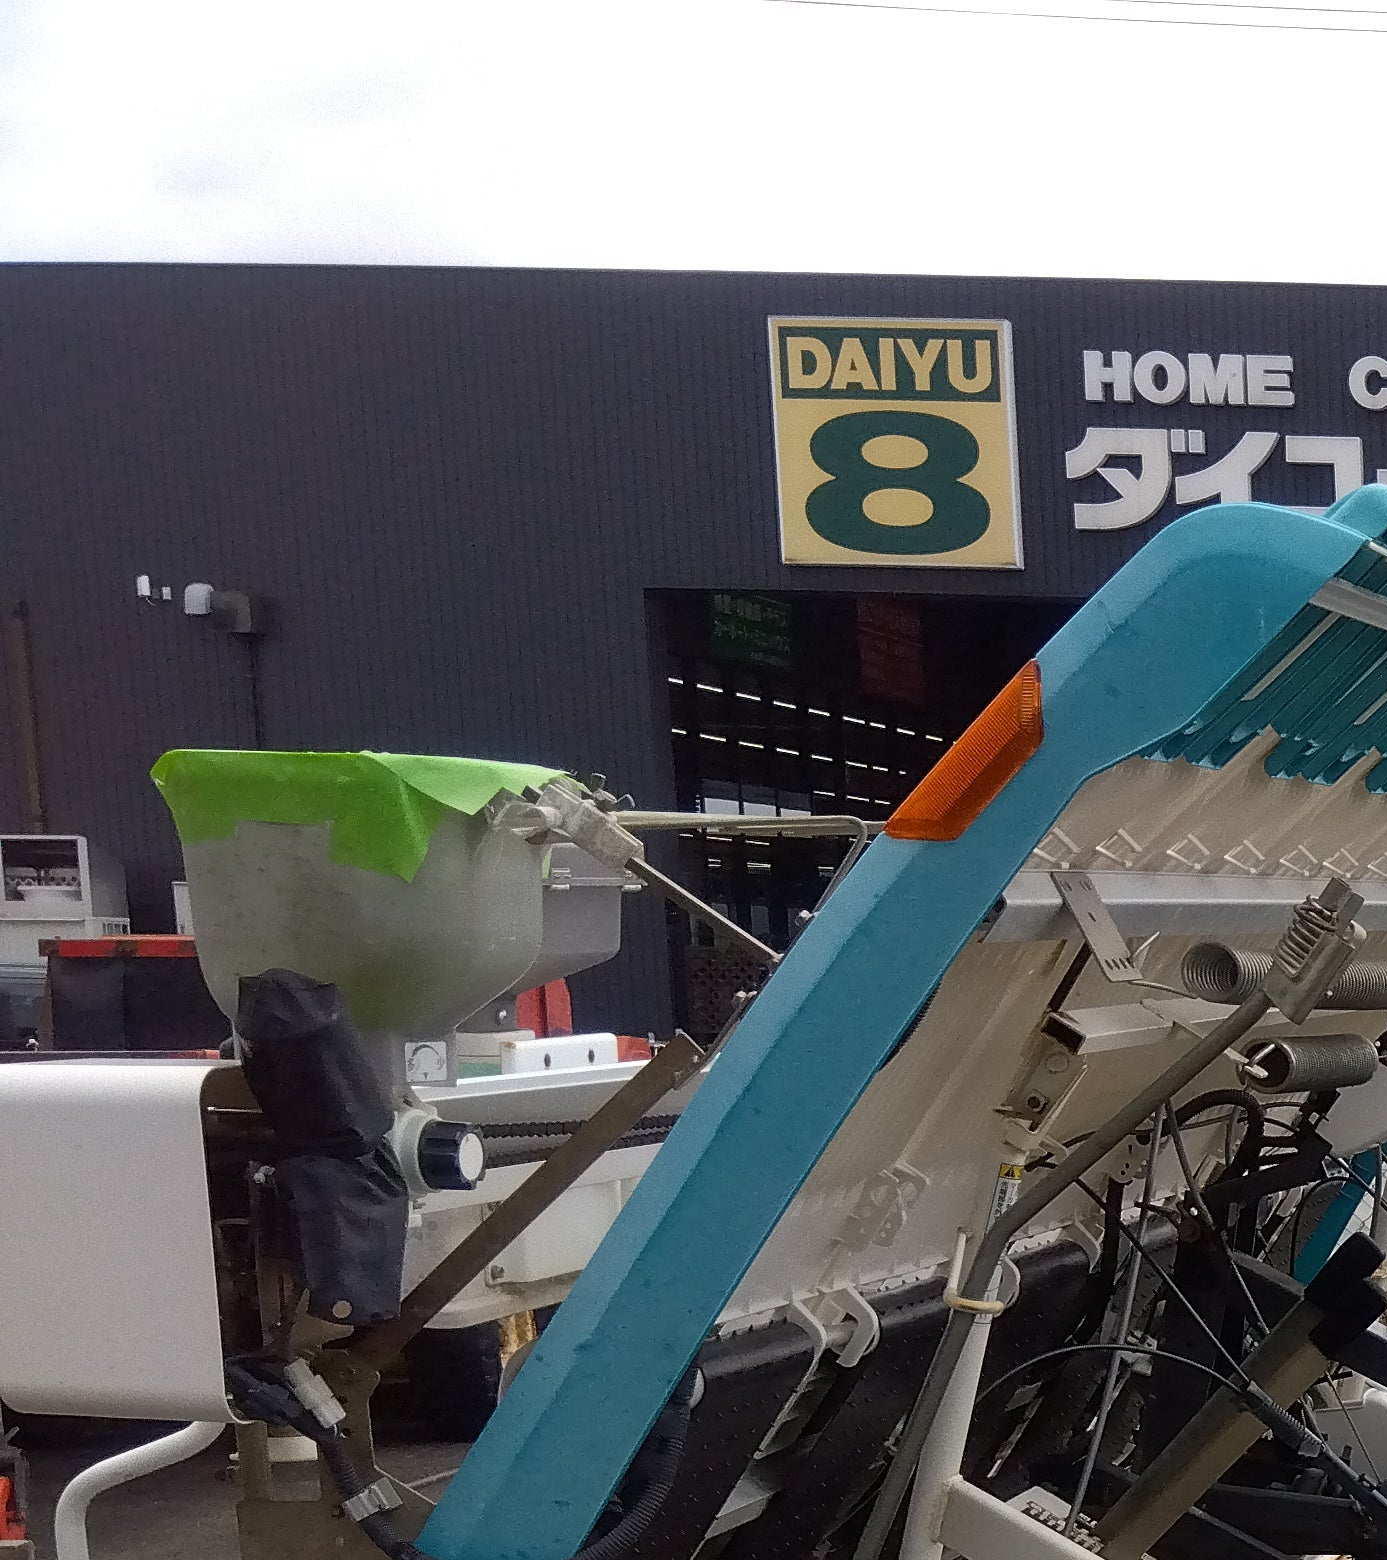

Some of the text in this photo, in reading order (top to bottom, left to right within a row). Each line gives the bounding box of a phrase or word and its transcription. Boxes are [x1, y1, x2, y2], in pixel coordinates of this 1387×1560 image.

[786, 335, 993, 394] DAIYU
[1082, 350, 1296, 408] HOME
[805, 409, 991, 555] 8
